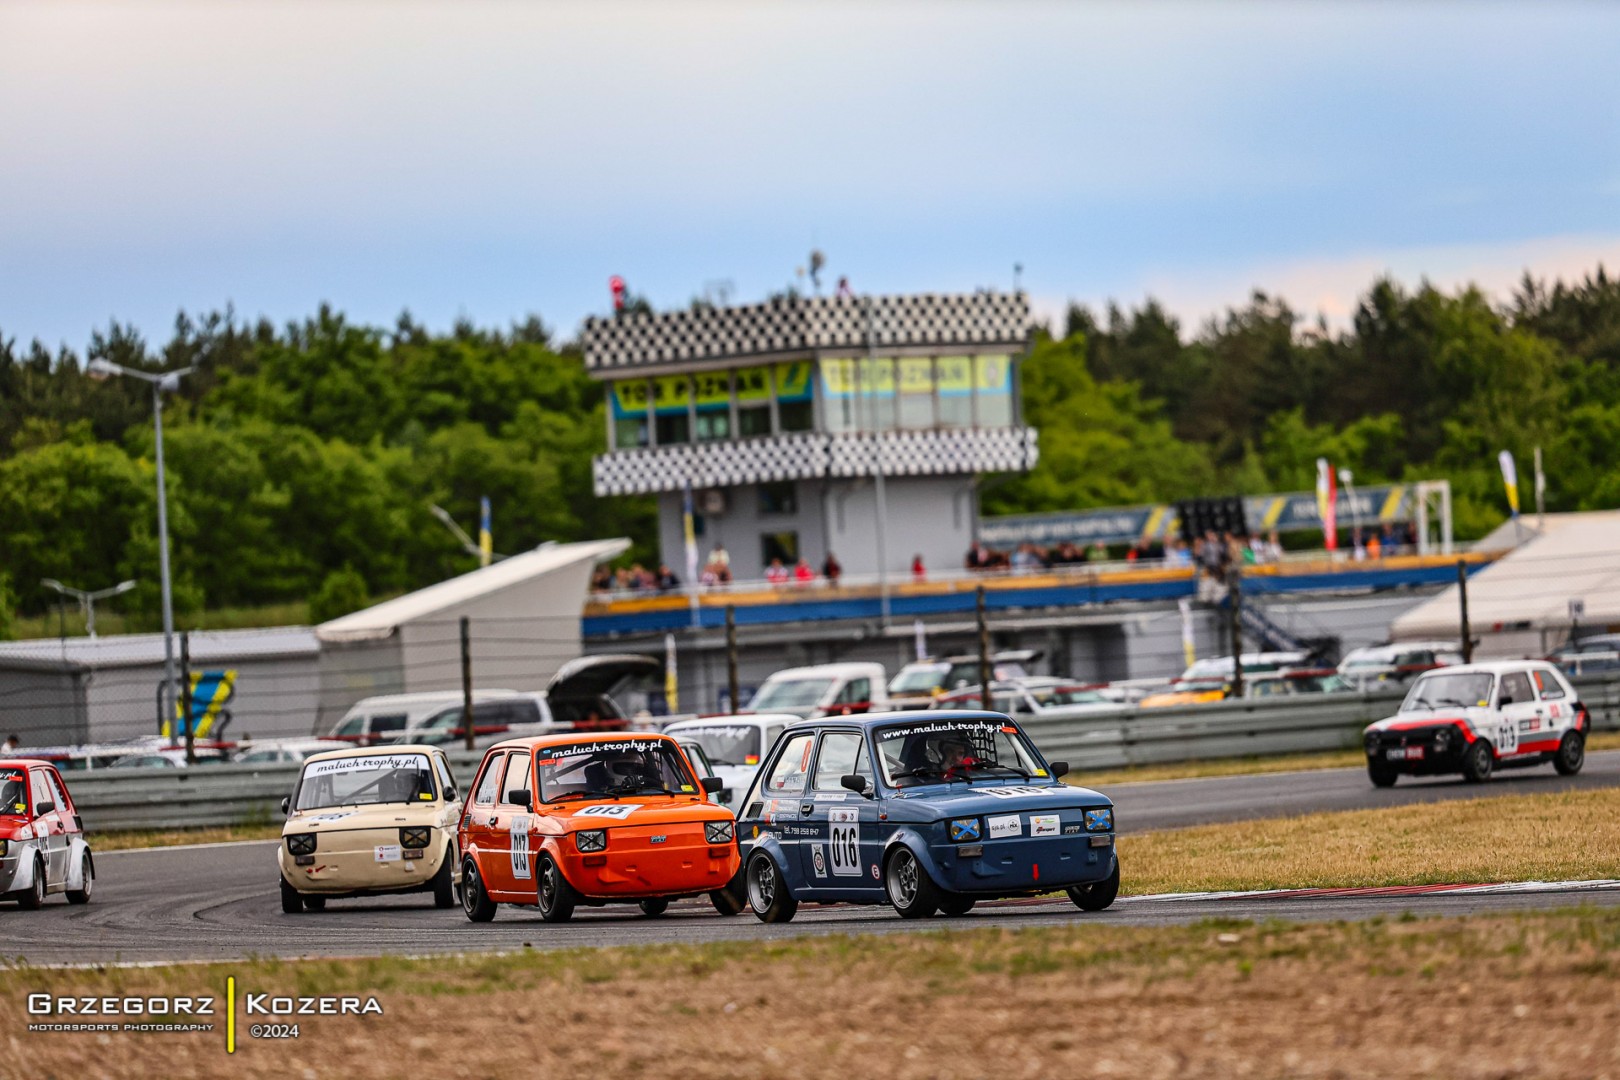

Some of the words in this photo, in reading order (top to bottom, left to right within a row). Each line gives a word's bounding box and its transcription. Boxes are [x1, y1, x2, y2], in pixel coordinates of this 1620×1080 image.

[551, 739, 663, 759] maluch-trophy.pl
[316, 756, 418, 773] maluch-trophy.pl
[584, 806, 628, 815] 013
[513, 833, 527, 871] 013
[832, 827, 858, 868] 016
